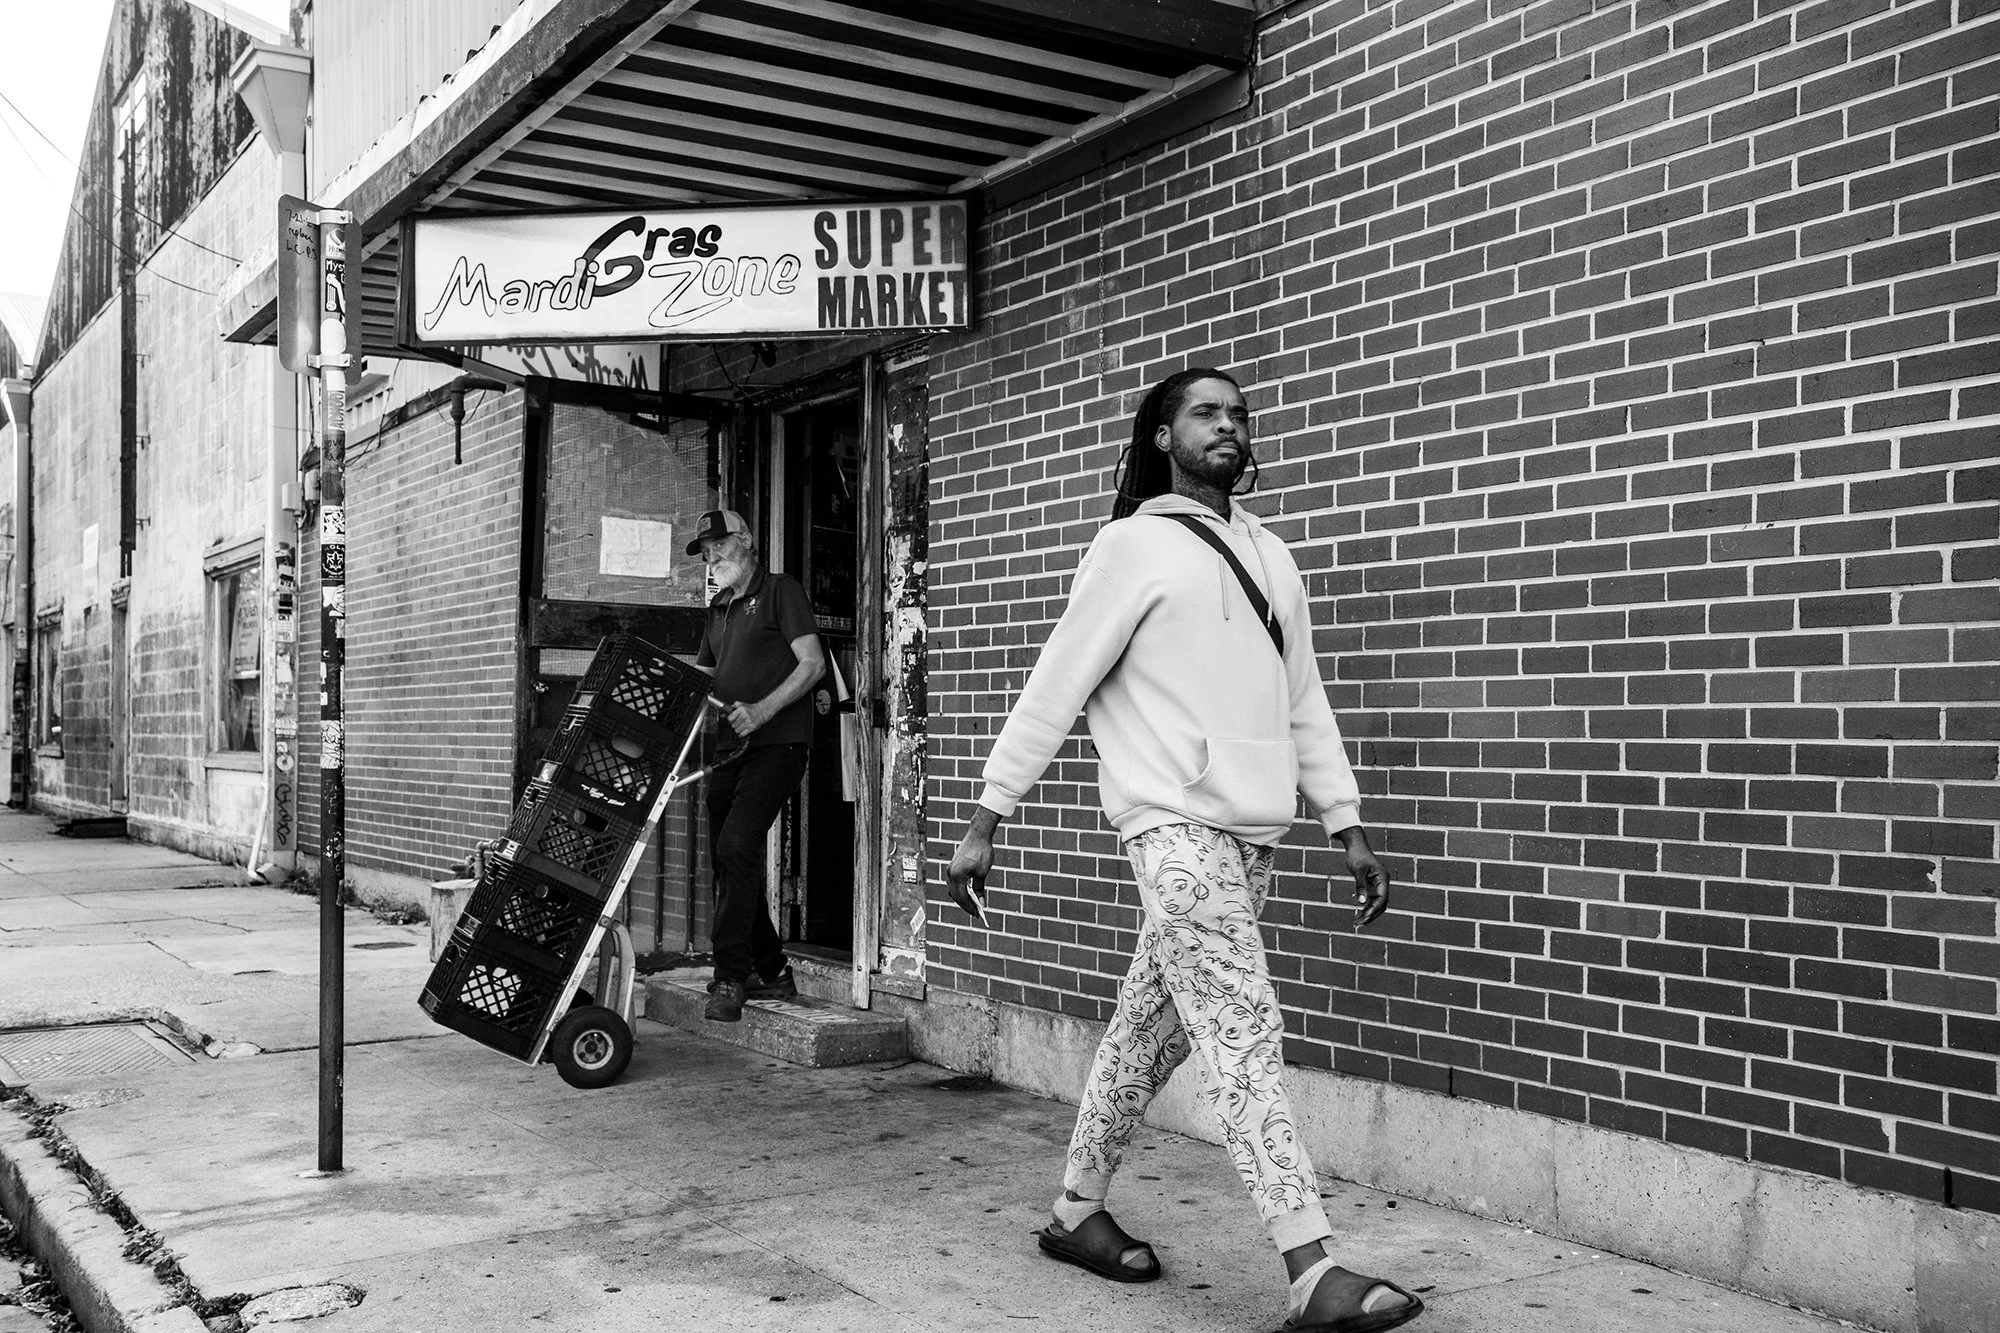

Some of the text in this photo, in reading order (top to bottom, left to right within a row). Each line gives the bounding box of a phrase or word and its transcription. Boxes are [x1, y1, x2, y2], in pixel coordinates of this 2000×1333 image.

[814, 204, 966, 270] SUPER
[423, 215, 722, 331] Mardi Gras
[648, 253, 801, 328] Zone
[817, 270, 967, 329] MARKET
